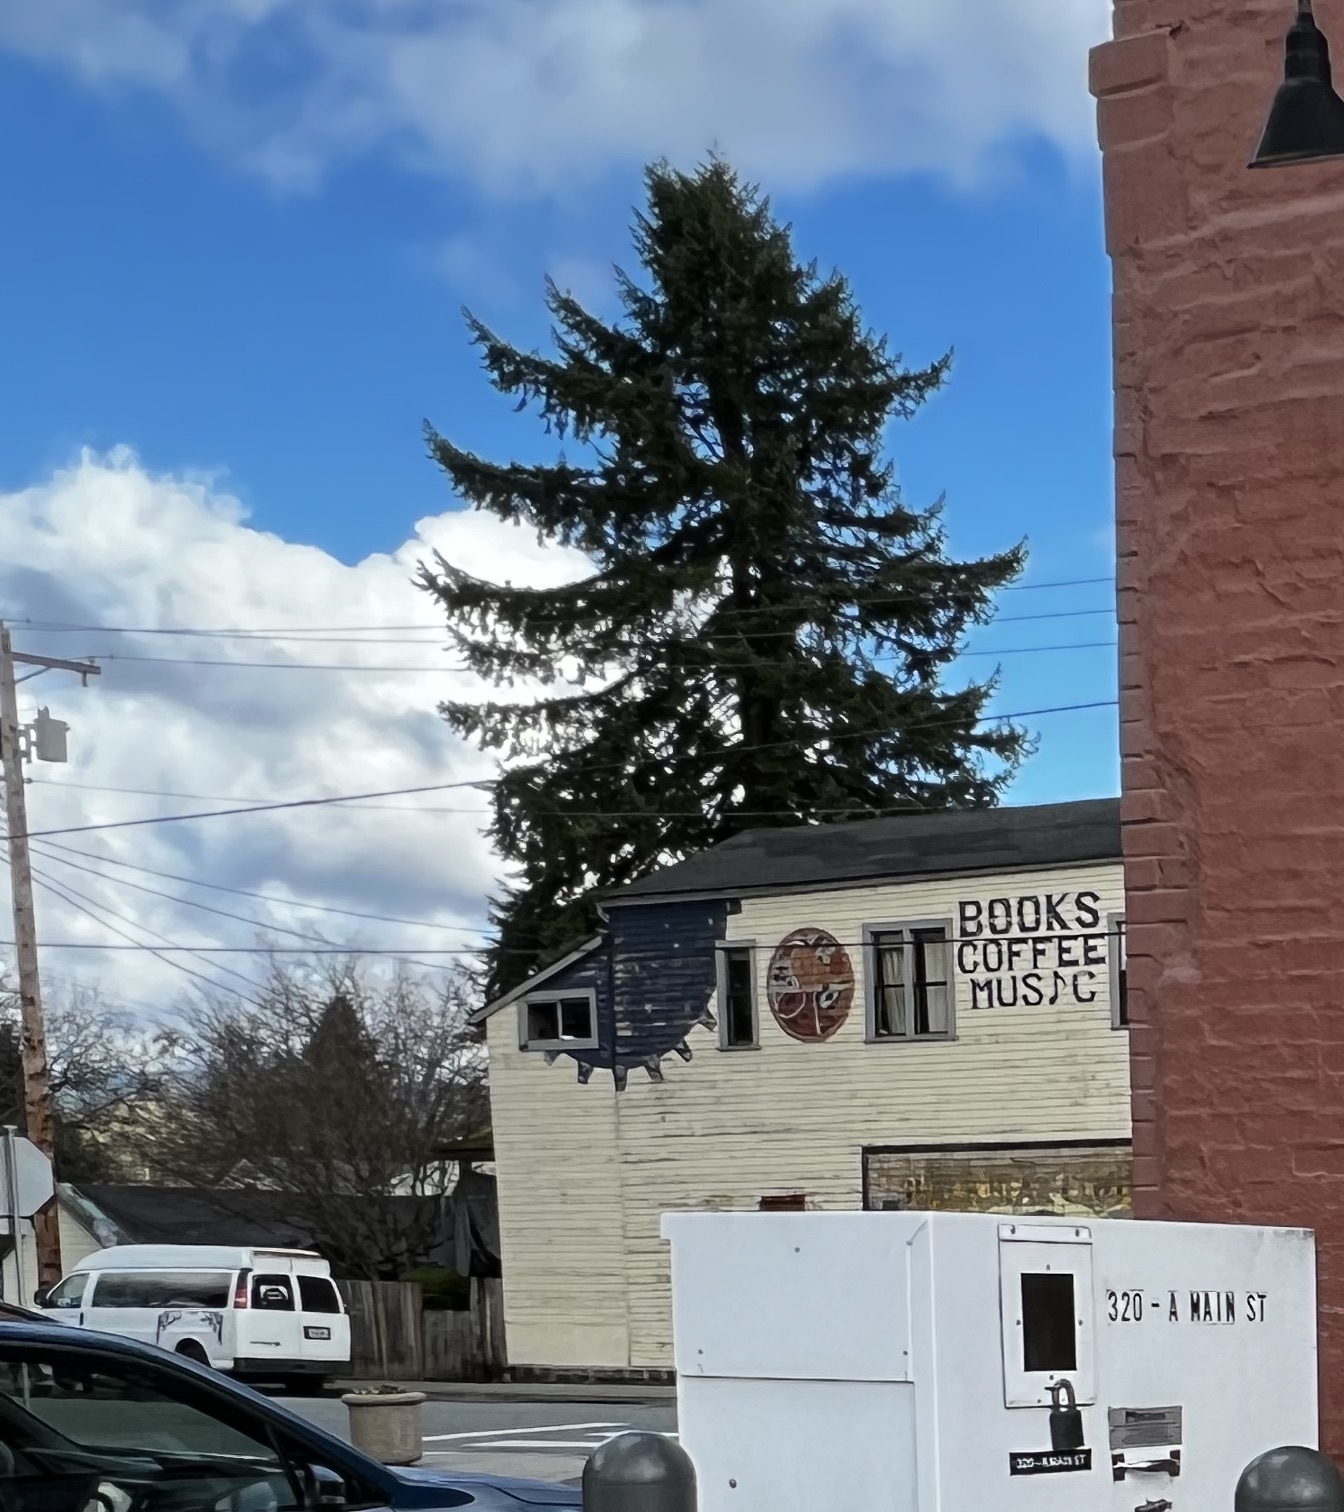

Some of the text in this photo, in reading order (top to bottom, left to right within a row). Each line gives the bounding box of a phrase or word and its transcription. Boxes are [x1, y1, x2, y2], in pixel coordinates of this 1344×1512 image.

[958, 891, 1101, 938] BOOKS
[957, 936, 1107, 974] COFFEE
[1107, 1290, 1143, 1322] 320
[1168, 1291, 1179, 1322] A
[1189, 1291, 1236, 1323] MAIN
[1245, 1292, 1268, 1322] ST
